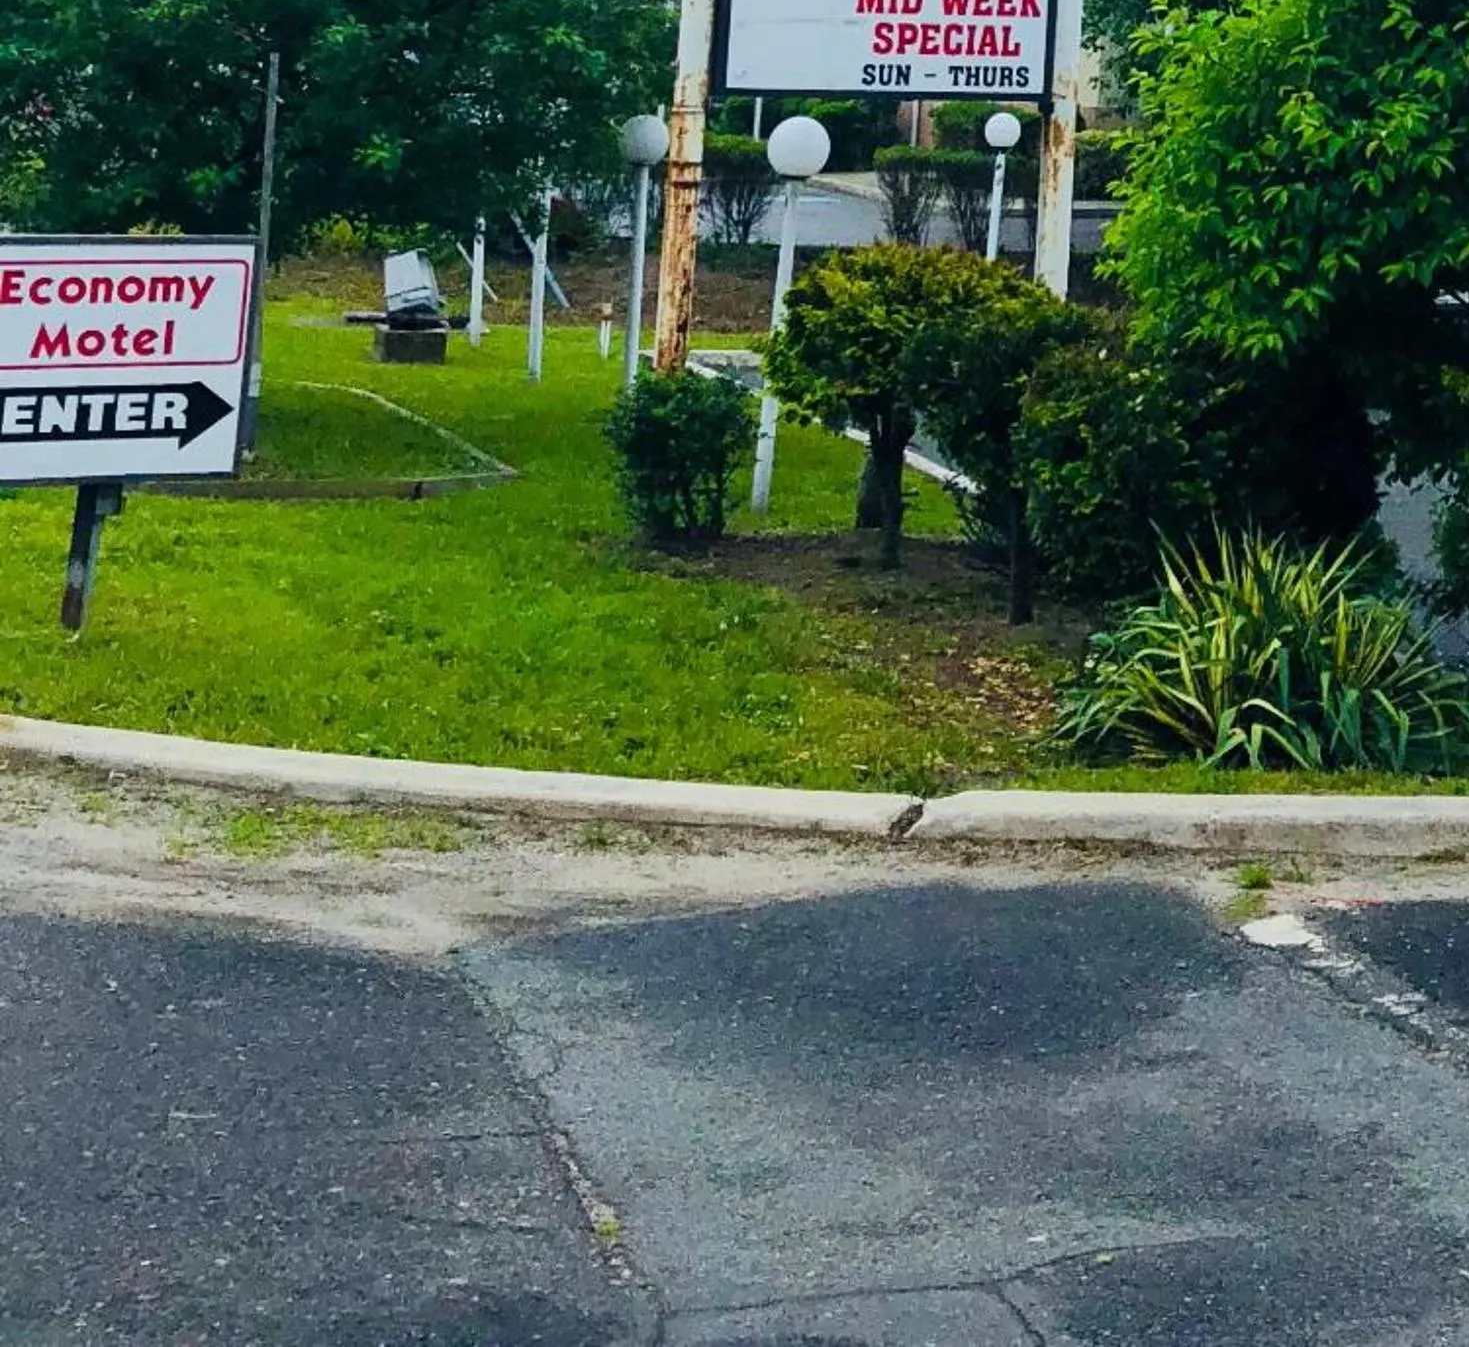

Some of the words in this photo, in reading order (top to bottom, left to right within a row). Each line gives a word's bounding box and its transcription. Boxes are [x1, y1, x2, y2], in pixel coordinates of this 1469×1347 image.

[873, 23, 1020, 57] SPECIAL
[861, 63, 911, 86] SUN
[948, 65, 1030, 88] THURS
[0, 270, 215, 309] Economy
[30, 321, 175, 358] Motel
[2, 392, 189, 434] ENTER
